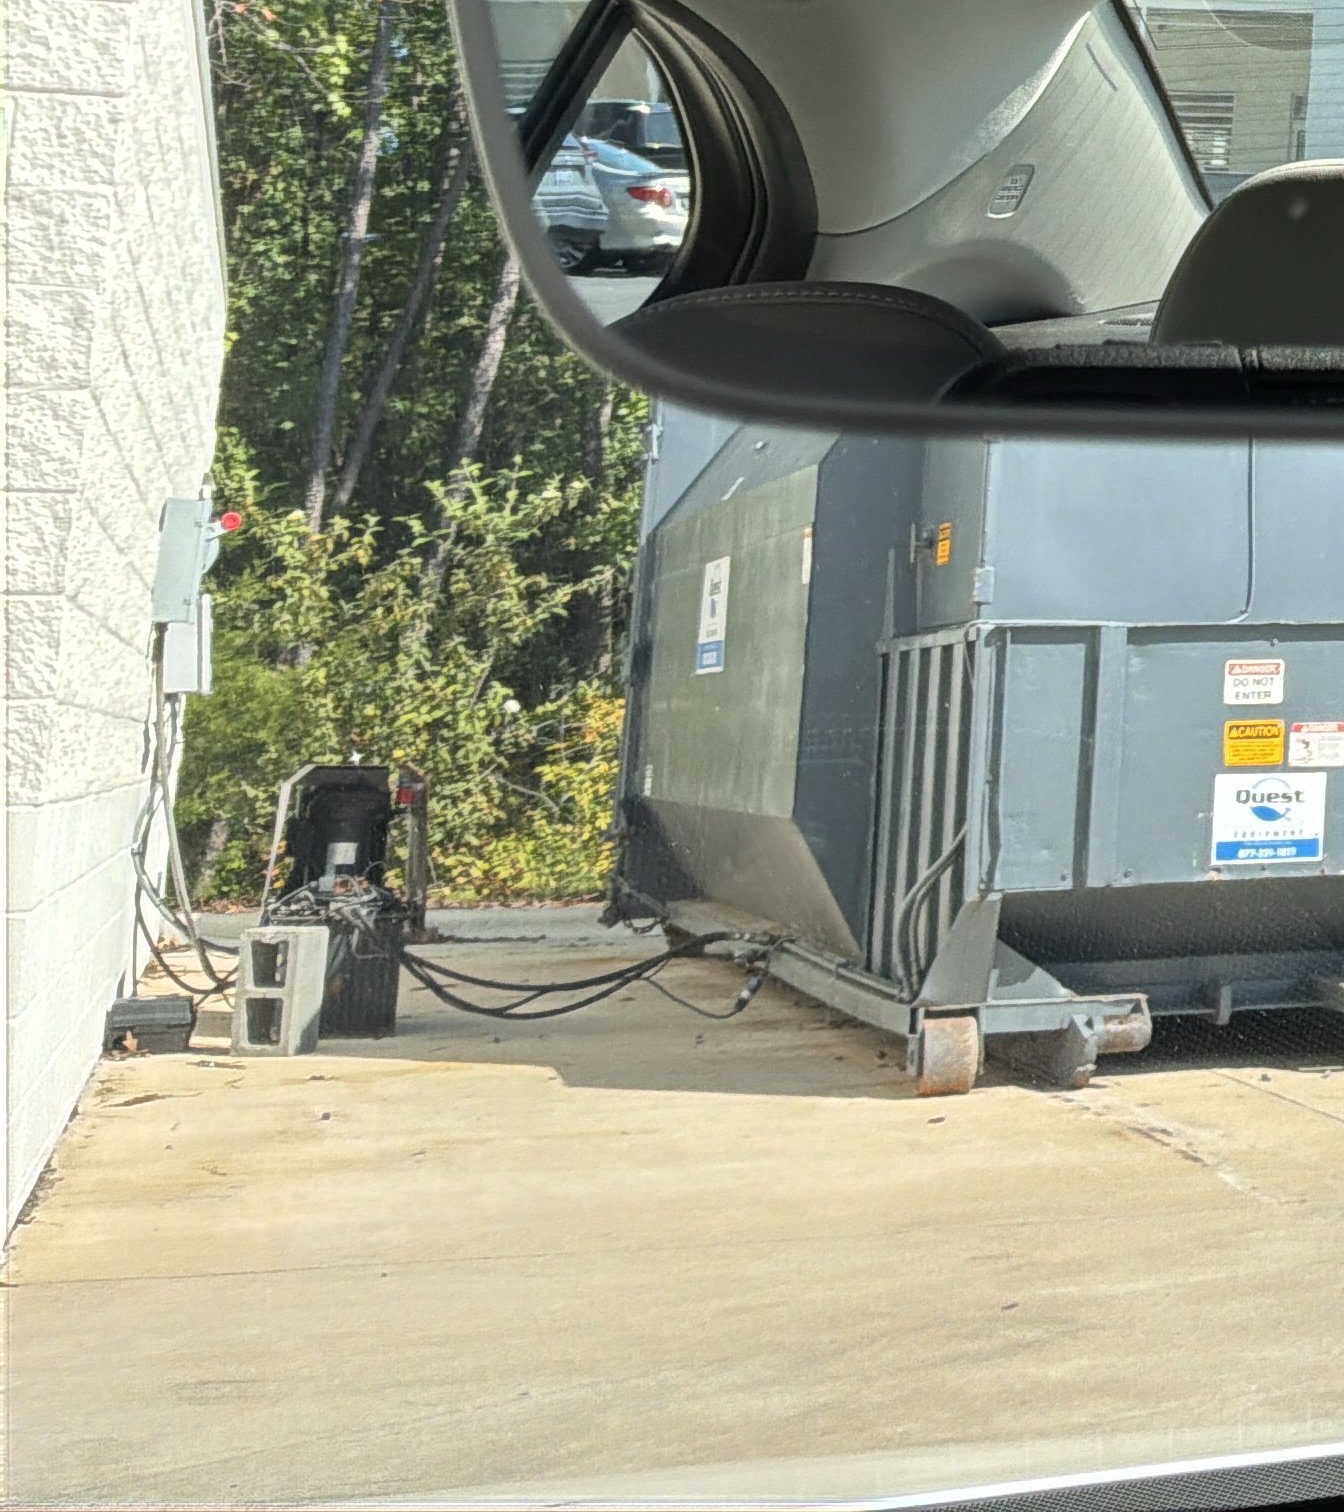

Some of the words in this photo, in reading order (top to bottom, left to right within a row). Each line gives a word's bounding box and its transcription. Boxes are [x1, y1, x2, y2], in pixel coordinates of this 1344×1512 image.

[1233, 677, 1249, 687] DO
[1252, 676, 1275, 686] NOT
[1234, 690, 1272, 700] ENTER
[1239, 726, 1279, 737] CAUTION
[1235, 789, 1305, 804] Quest
